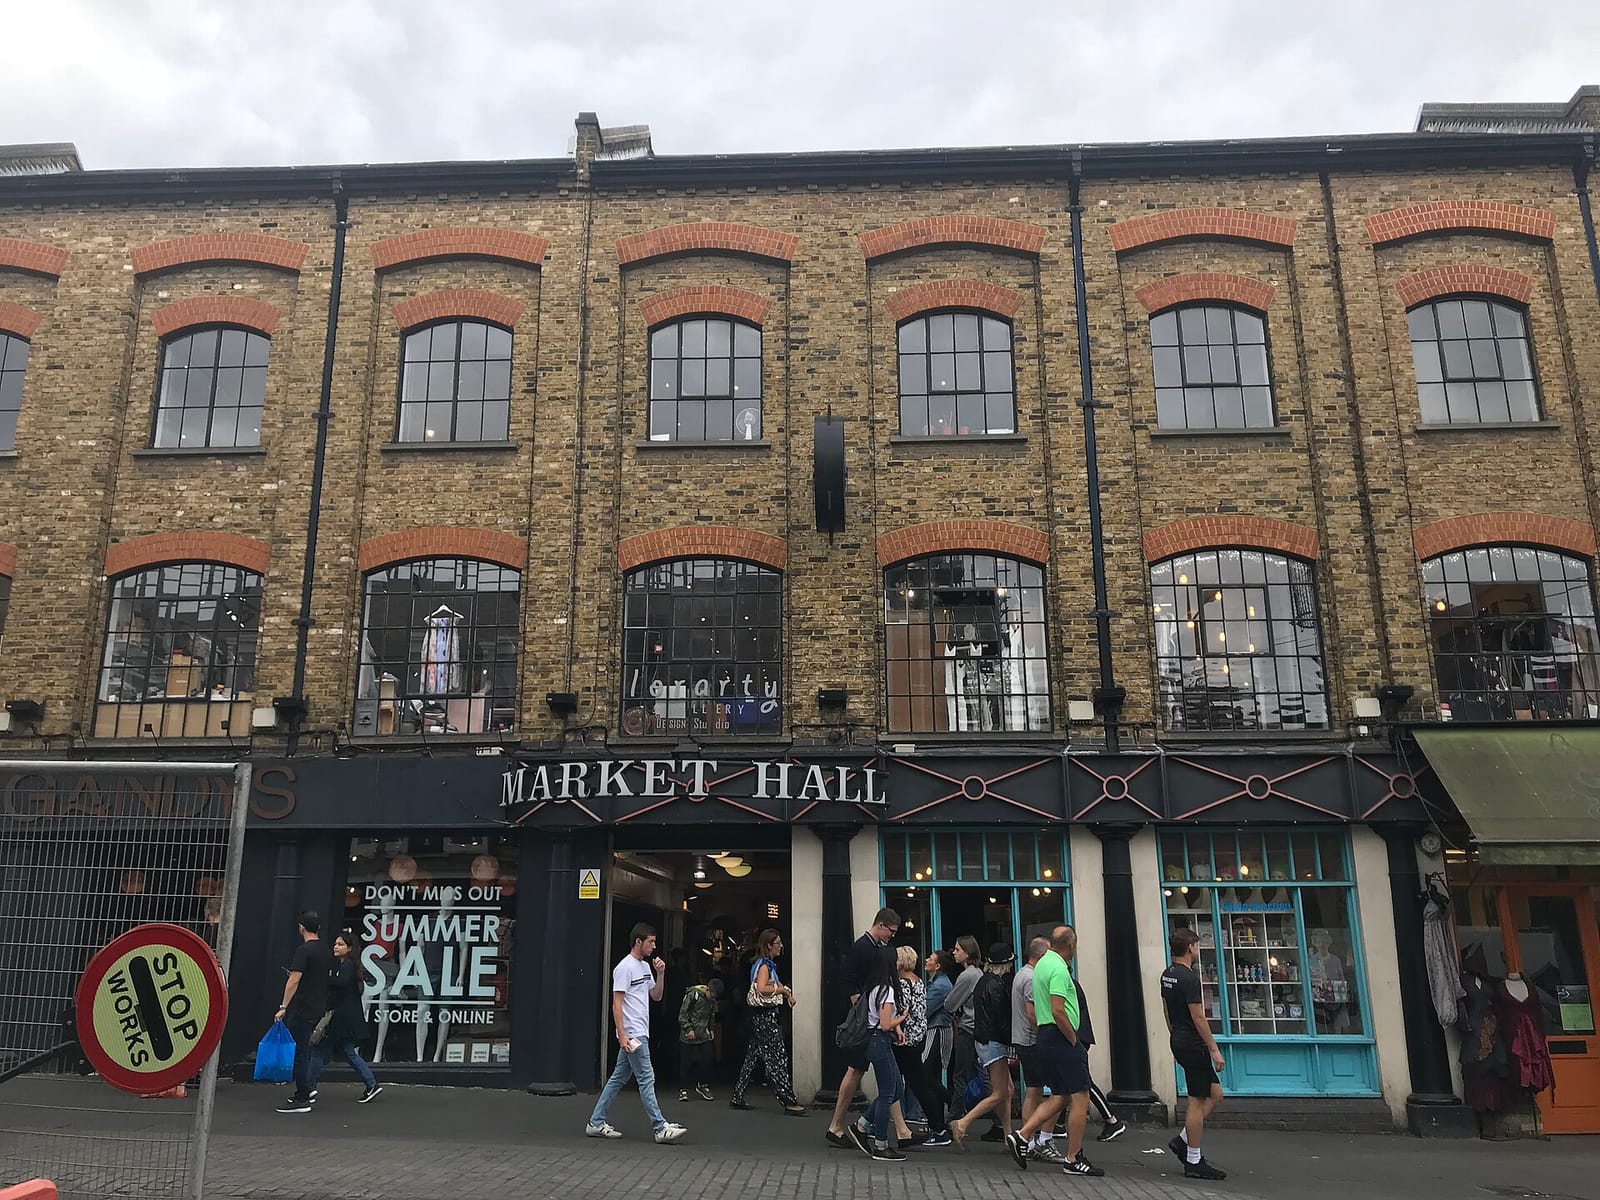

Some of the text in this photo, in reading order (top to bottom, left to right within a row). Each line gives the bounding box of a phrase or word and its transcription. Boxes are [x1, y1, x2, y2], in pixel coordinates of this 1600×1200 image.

[499, 760, 887, 806] MARKET HALL
[365, 885, 503, 901] DON'T MIS OUT
[360, 913, 500, 943] SUMMER
[360, 944, 498, 997] SALE
[107, 969, 149, 1067] WORKS
[152, 952, 198, 1041] STOP
[374, 1009, 418, 1023] STORE
[423, 1011, 434, 1023] &
[438, 1009, 495, 1024] ONLINE
